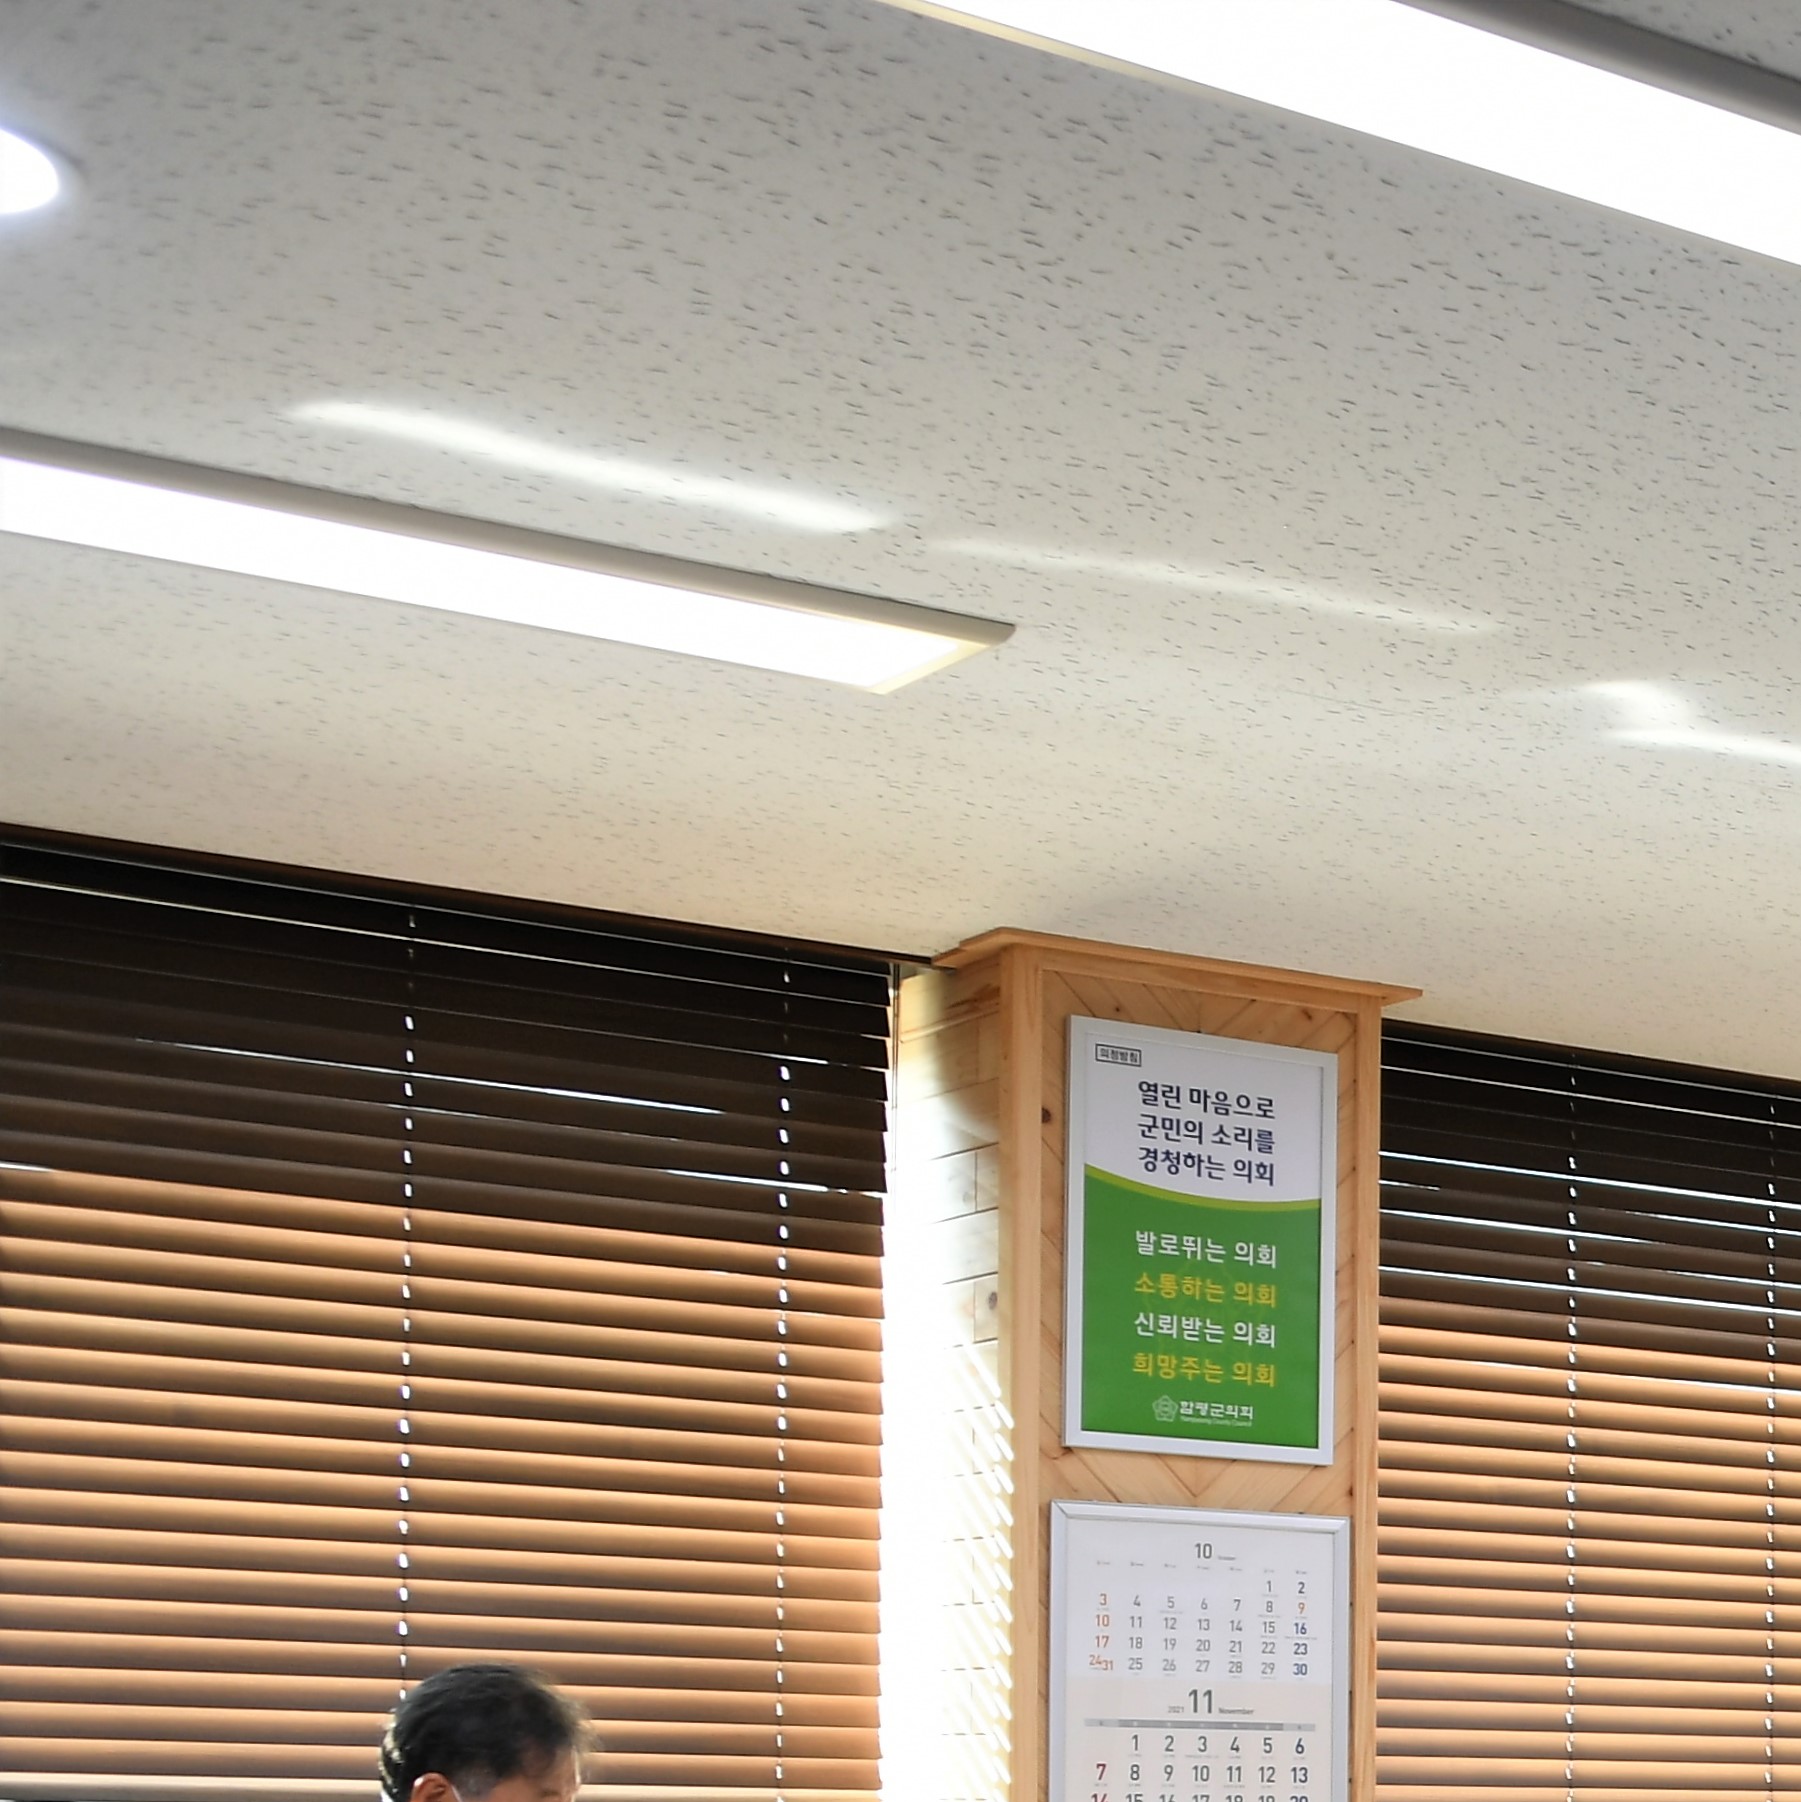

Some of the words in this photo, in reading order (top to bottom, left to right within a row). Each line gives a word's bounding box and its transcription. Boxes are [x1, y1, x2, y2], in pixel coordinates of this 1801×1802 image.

[1138, 1081, 1182, 1111] 열린
[1189, 1087, 1275, 1119] 마음으로
[1137, 1114, 1204, 1145] 군민의
[1211, 1126, 1275, 1154] 소리를
[1138, 1147, 1226, 1179] 경청하는
[1233, 1158, 1274, 1186] 의회
[1135, 1229, 1226, 1263] 발로뛰는
[1235, 1242, 1277, 1268] 의회
[1134, 1273, 1225, 1304] 소통하는
[1234, 1280, 1277, 1307] 의회
[1134, 1312, 1225, 1344] 신뢰받는
[1233, 1322, 1276, 1348] 의회
[1133, 1352, 1224, 1382] 희망주는
[1233, 1361, 1276, 1387] 의회
[1194, 1542, 1213, 1560] 10
[1266, 1580, 1272, 1593] 1
[1297, 1581, 1306, 1595] 2
[1099, 1592, 1108, 1606] 3
[1133, 1594, 1142, 1607] 4
[1167, 1595, 1175, 1609] 5
[1200, 1597, 1208, 1611] 6
[1233, 1598, 1242, 1612] 7
[1265, 1600, 1274, 1614] 8
[1297, 1601, 1306, 1615] 9
[1095, 1613, 1110, 1628] 10
[1129, 1615, 1143, 1629] 11
[1163, 1616, 1178, 1631] 12
[1197, 1618, 1211, 1632] 13
[1229, 1619, 1243, 1632] 14
[1262, 1620, 1276, 1634] 15
[1293, 1622, 1307, 1635] 16
[1095, 1635, 1110, 1649] 17
[1128, 1636, 1143, 1650] 18
[1163, 1637, 1177, 1651] 19
[1195, 1638, 1211, 1652] 20
[1228, 1640, 1242, 1653] 21
[1261, 1641, 1276, 1655] 22
[1293, 1642, 1308, 1656] 23
[1101, 1659, 1114, 1672] 31
[1128, 1657, 1143, 1671] 25
[1162, 1658, 1177, 1672] 26
[1195, 1659, 1211, 1673] 27
[1228, 1660, 1243, 1674] 28
[1260, 1661, 1276, 1675] 29
[1292, 1662, 1308, 1676] 30
[1188, 1688, 1213, 1714] 11
[1131, 1734, 1139, 1752] 1
[1164, 1734, 1175, 1753] 2
[1197, 1735, 1208, 1753] 3
[1229, 1736, 1241, 1753] 4
[1263, 1736, 1273, 1754] 5
[1295, 1737, 1305, 1755] 6
[1096, 1763, 1107, 1781] 7
[1129, 1763, 1140, 1781] 8
[1163, 1764, 1174, 1782] 9
[1191, 1764, 1210, 1782] 10
[1226, 1765, 1242, 1783] 11
[1258, 1765, 1276, 1784] 12
[1290, 1766, 1308, 1784] 13
